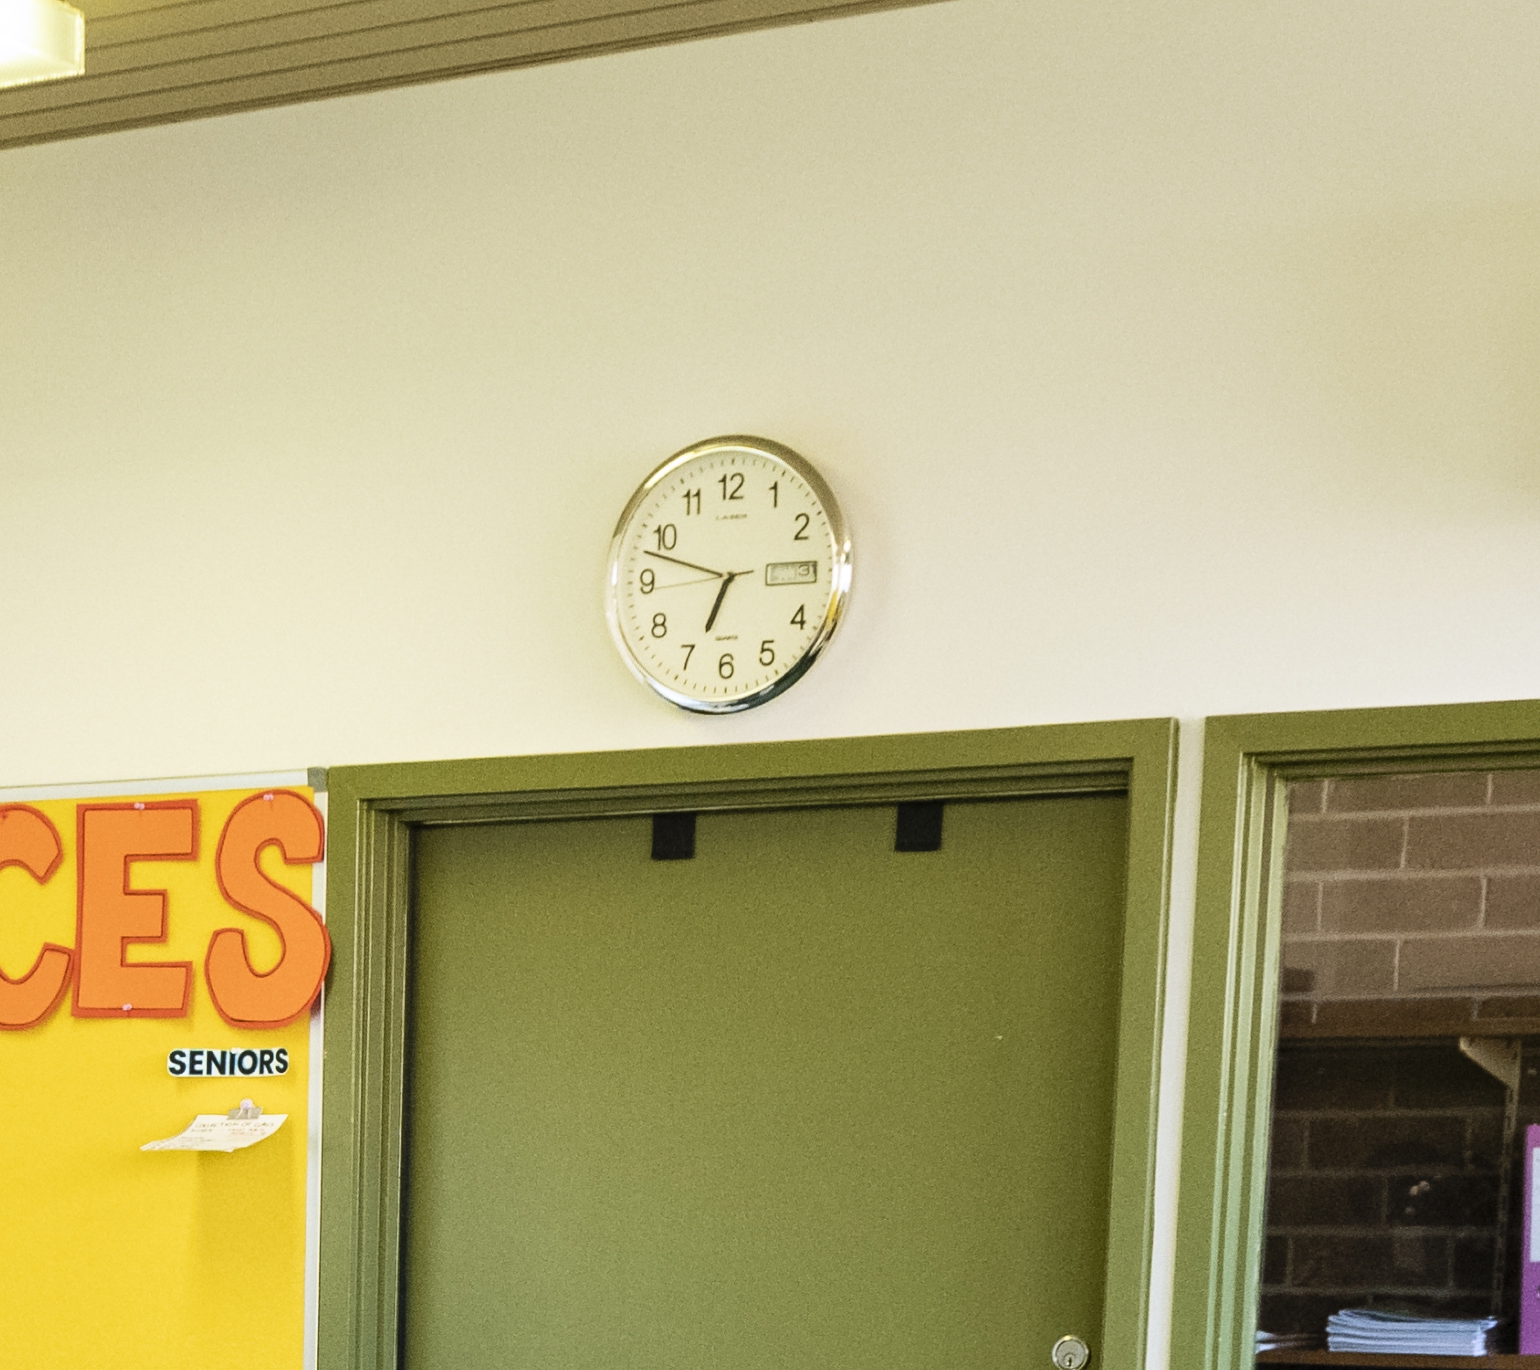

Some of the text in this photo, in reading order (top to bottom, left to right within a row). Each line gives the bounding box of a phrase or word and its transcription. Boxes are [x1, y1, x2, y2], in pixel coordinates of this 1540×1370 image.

[718, 472, 744, 501] 12
[768, 481, 779, 508] 1
[681, 488, 702, 515] 11
[653, 523, 677, 550] 10
[793, 513, 810, 541] 2
[639, 568, 656, 594] 9
[651, 612, 667, 638] 8
[790, 604, 806, 630] 4
[680, 643, 696, 671] 7
[718, 653, 735, 679] 6
[759, 639, 776, 666] 5
[168, 1047, 289, 1076] SENIORS
